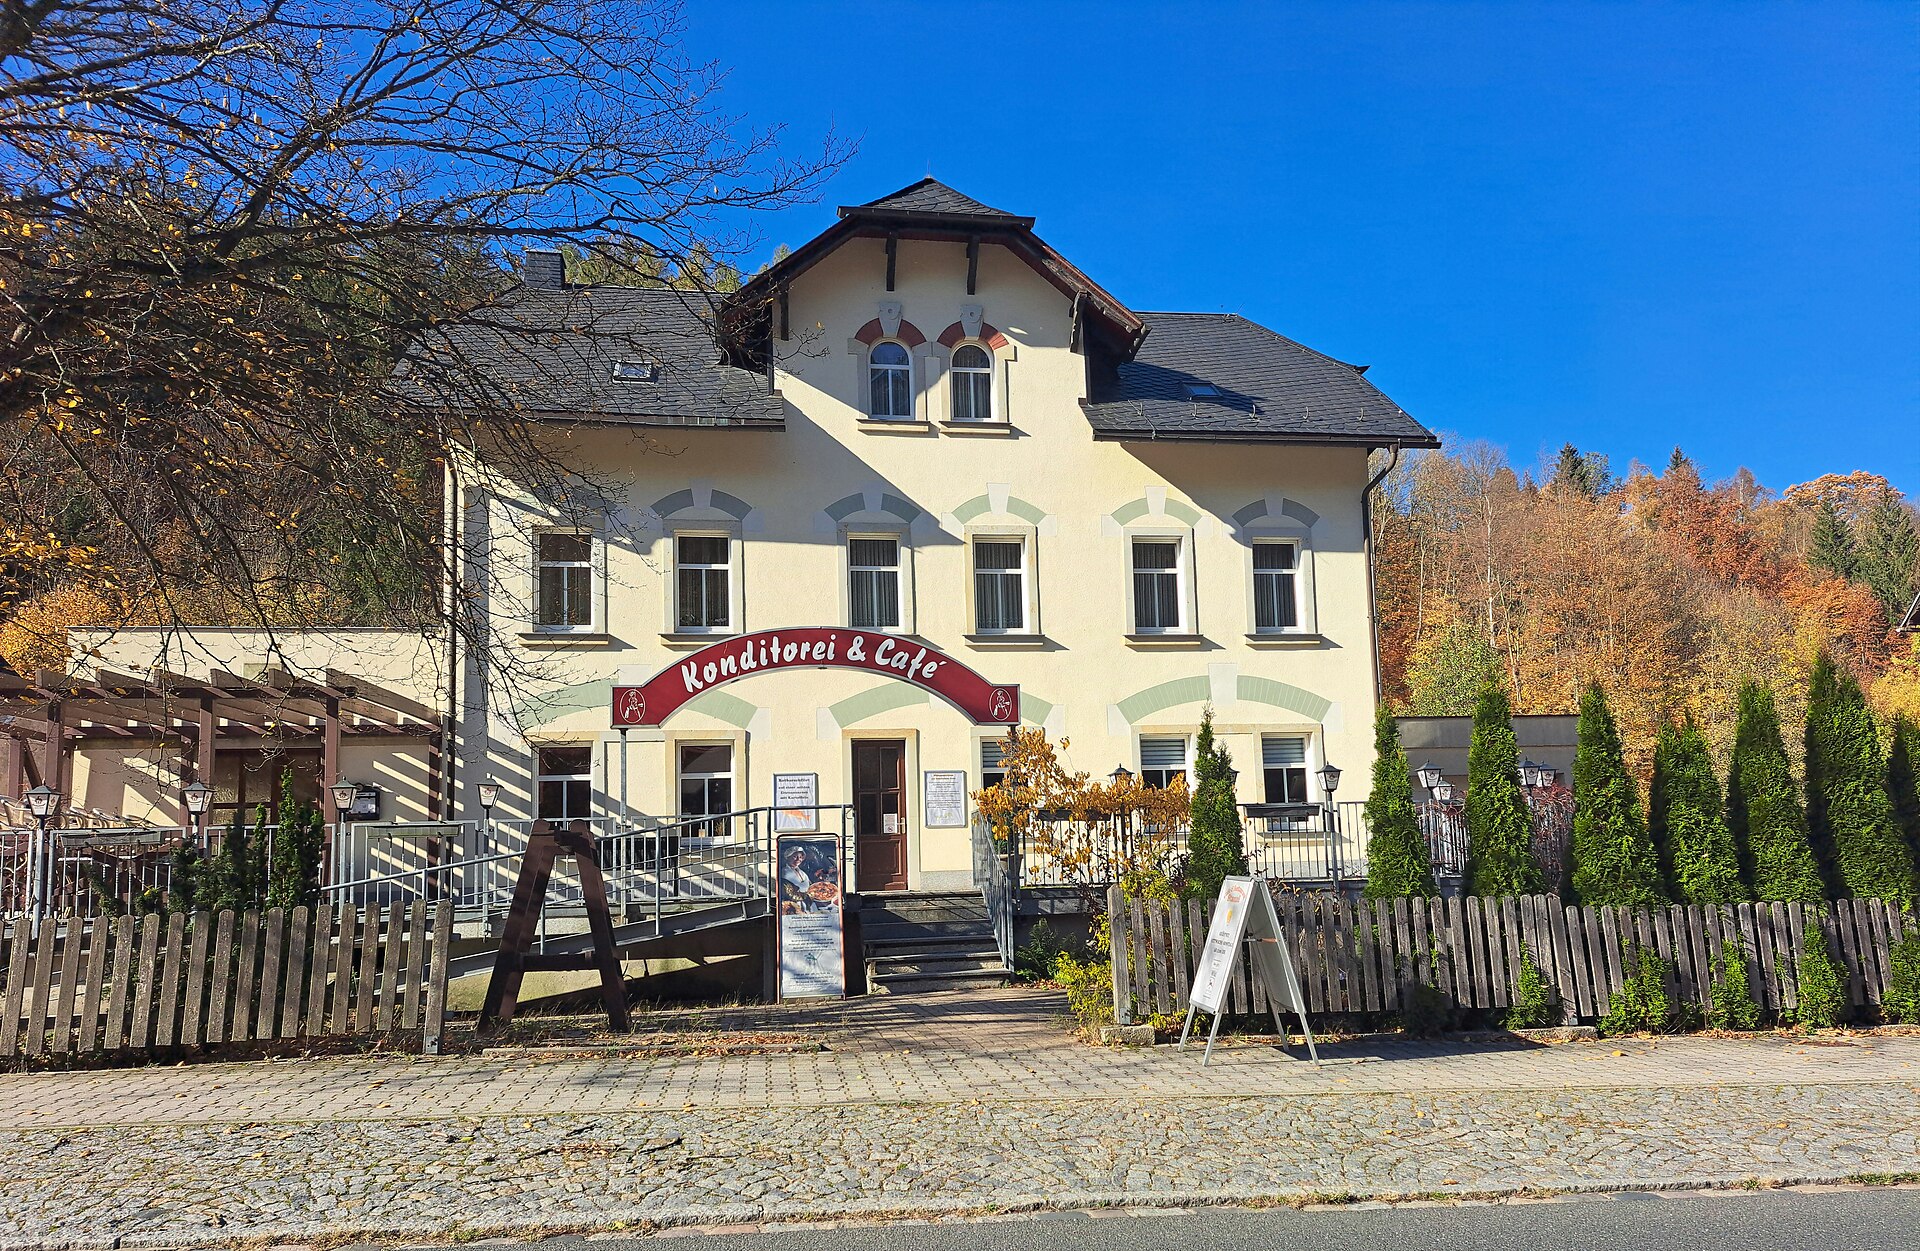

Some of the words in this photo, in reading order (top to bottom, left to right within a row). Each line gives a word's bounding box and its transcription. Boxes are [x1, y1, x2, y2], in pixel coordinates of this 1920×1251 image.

[681, 634, 837, 693] Konditorei
[846, 635, 867, 662] &
[874, 638, 948, 680] Café
